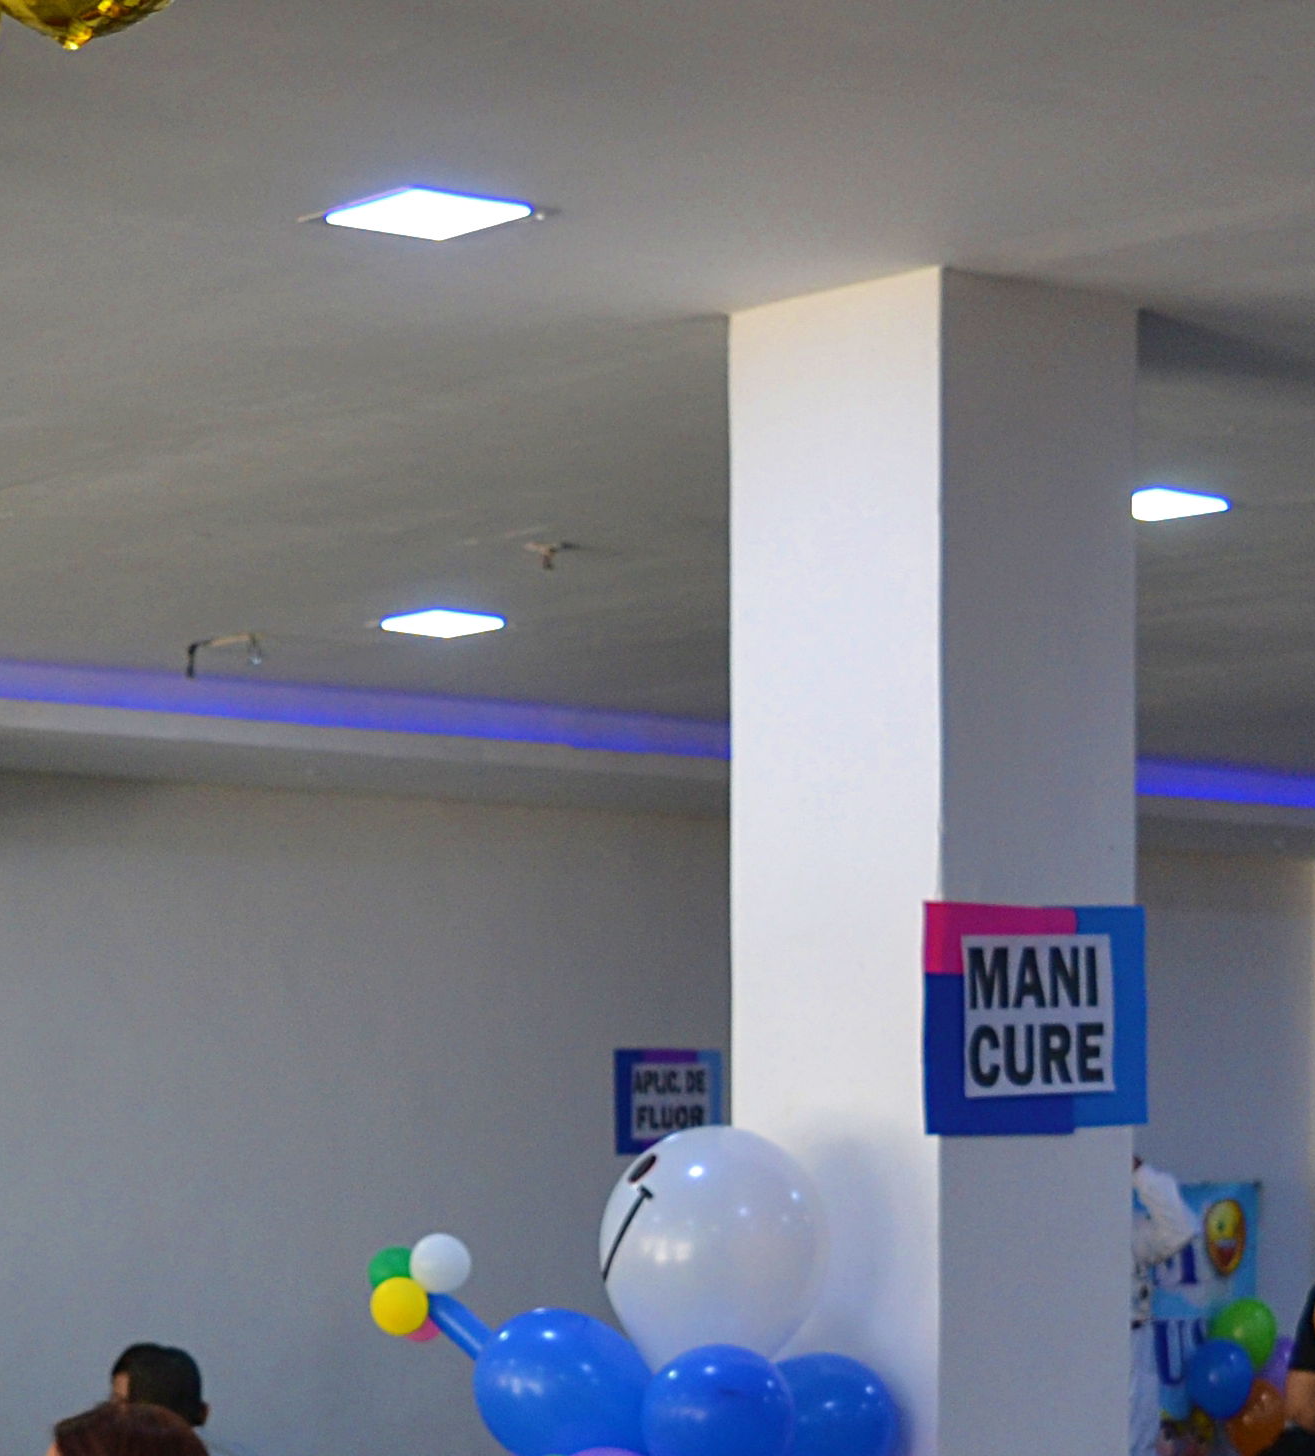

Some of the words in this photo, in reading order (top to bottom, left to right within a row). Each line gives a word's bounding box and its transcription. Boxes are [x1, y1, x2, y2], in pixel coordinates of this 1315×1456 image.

[967, 945, 1100, 1010] MANI
[685, 1069, 706, 1095] DE
[968, 1021, 1105, 1088] CURE
